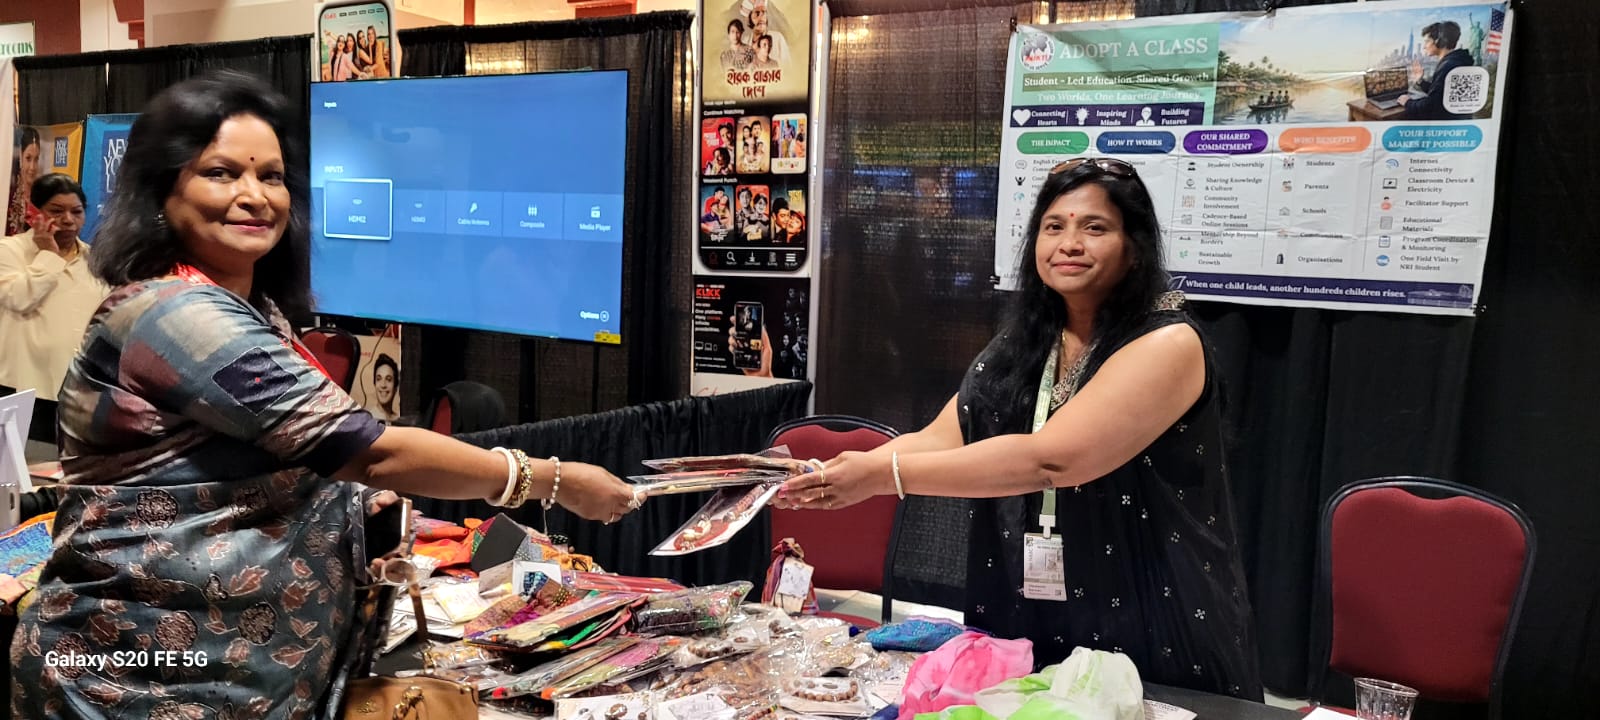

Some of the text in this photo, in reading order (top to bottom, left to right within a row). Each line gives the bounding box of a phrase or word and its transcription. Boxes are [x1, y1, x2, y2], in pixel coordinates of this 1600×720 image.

[1059, 37, 1208, 59] ADOPT A CLASS
[1024, 76, 1058, 87] Student
[1067, 76, 1085, 86] Led
[1136, 74, 1170, 84] Shared
[1172, 72, 1209, 83] Growth
[1038, 93, 1056, 102] Two
[1057, 92, 1093, 103] Worlds,
[1094, 92, 1115, 102] One
[1116, 91, 1158, 103] Learning
[1031, 110, 1066, 119] Connecting
[1096, 110, 1127, 119] Inspiring
[1160, 108, 1190, 117] Building
[1161, 118, 1187, 126] Futures
[1218, 133, 1250, 141] SHARED
[1399, 129, 1468, 138] YOUR SUPPORT
[1107, 139, 1125, 147] HOW
[1316, 135, 1356, 143] BENEFITS
[1196, 143, 1253, 151] COMMITMENT
[1388, 140, 1476, 149] MAKES IT POSSIBLE
[324, 165, 344, 173] INPUTS
[1232, 161, 1265, 170] Ownership
[1206, 177, 1263, 185] Sharing Knowledge
[1407, 186, 1442, 194] Electricity
[1204, 195, 1238, 203] Community
[1441, 200, 1469, 208] Support
[579, 223, 612, 232] Media Player
[1201, 220, 1248, 229] Online Sessions
[1236, 232, 1259, 240] Beyond
[1402, 236, 1432, 244] Program
[1408, 245, 1446, 253] Monitoring
[1450, 256, 1459, 264] by
[1186, 279, 1407, 298] When one child leads, another hundreds children rises.
[580, 310, 600, 320] Options
